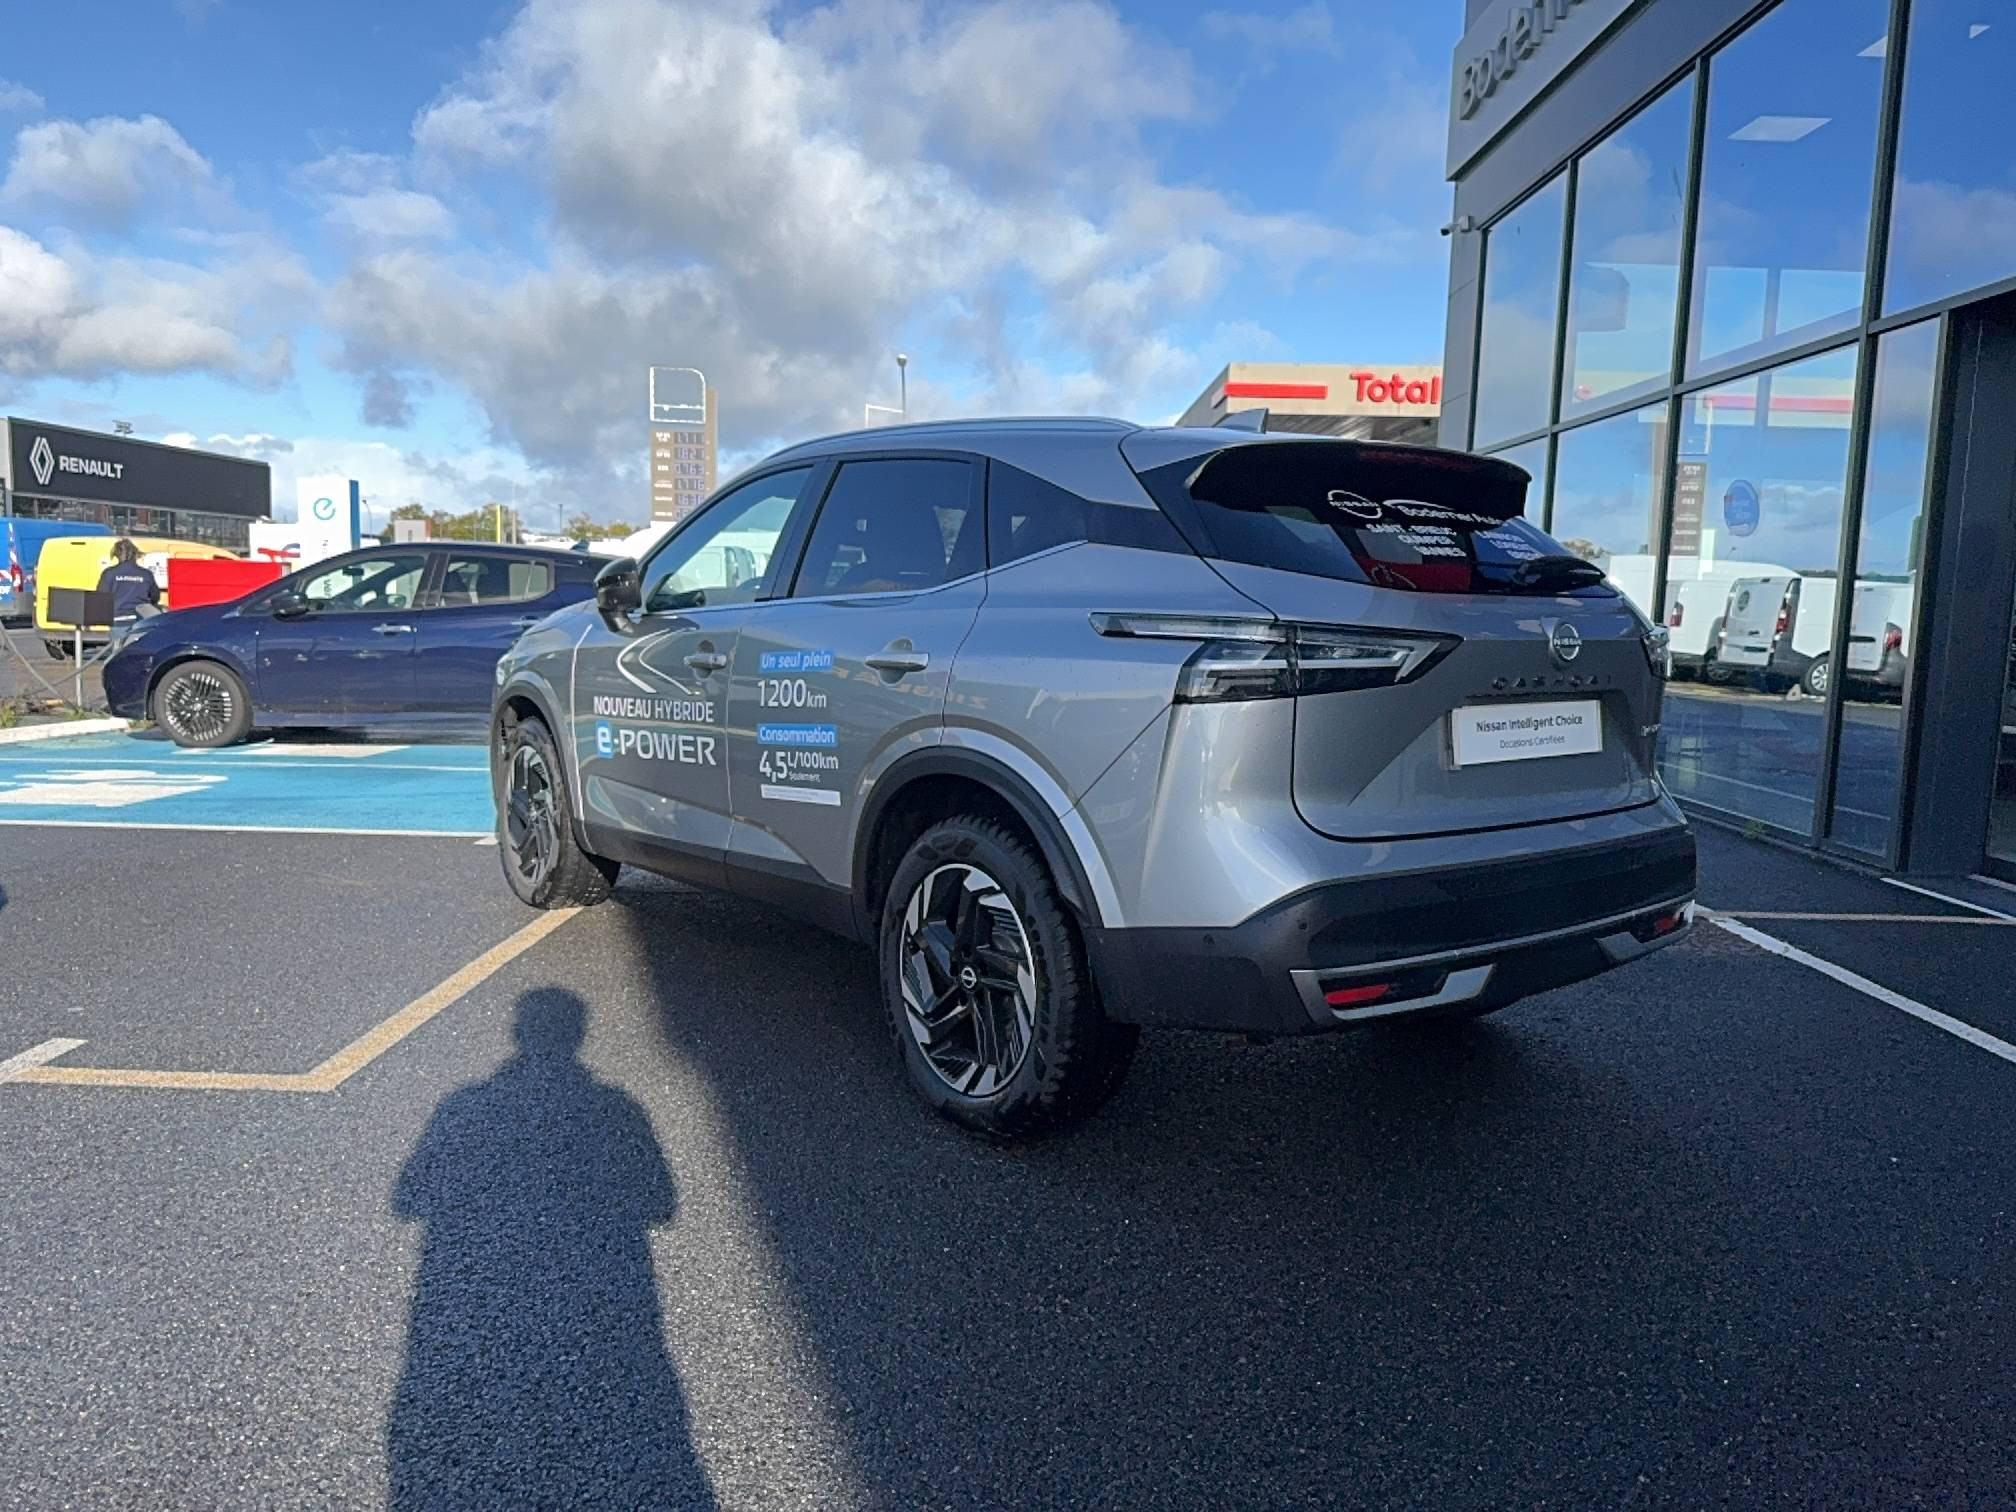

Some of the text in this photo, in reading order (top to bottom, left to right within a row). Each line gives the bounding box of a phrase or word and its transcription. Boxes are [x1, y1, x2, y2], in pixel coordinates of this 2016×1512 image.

[1351, 371, 1442, 405] Total
[59, 455, 124, 479] RENAULT
[761, 651, 832, 672] Un seul plein
[593, 695, 715, 723] NOUVEAU HYBRIDE
[1476, 713, 1583, 733] Nissan Intelligent Choice
[760, 726, 836, 744] Consommation
